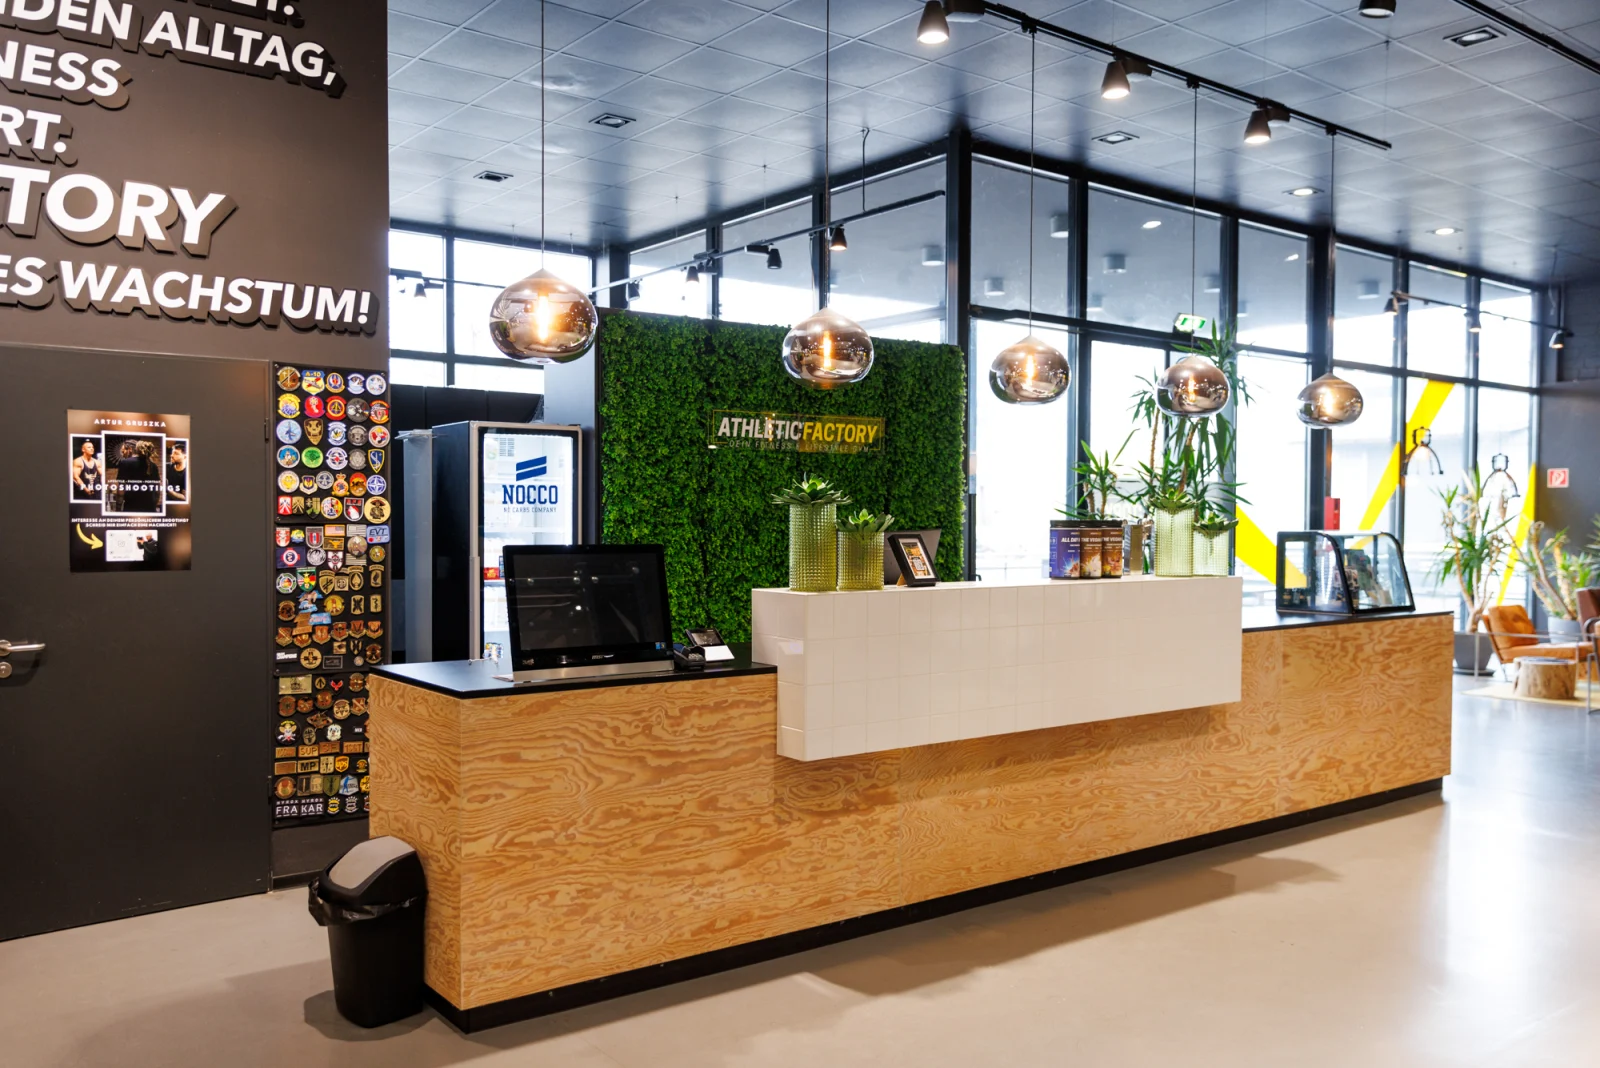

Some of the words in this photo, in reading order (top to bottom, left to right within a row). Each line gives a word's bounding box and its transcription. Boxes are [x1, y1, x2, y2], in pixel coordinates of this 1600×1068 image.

[0, 0, 133, 40] DEN
[143, 11, 337, 86] ALLTAG,
[0, 104, 67, 153] RT.
[0, 163, 226, 244] TORY
[59, 260, 372, 324] WACHSTUM!
[94, 418, 123, 426] ARTUR
[80, 482, 181, 493] PHOTOSHOOTINGS
[502, 484, 558, 505] NOCCO
[300, 761, 316, 771] MP
[276, 805, 298, 815] FRA
[301, 803, 323, 813] KAR
